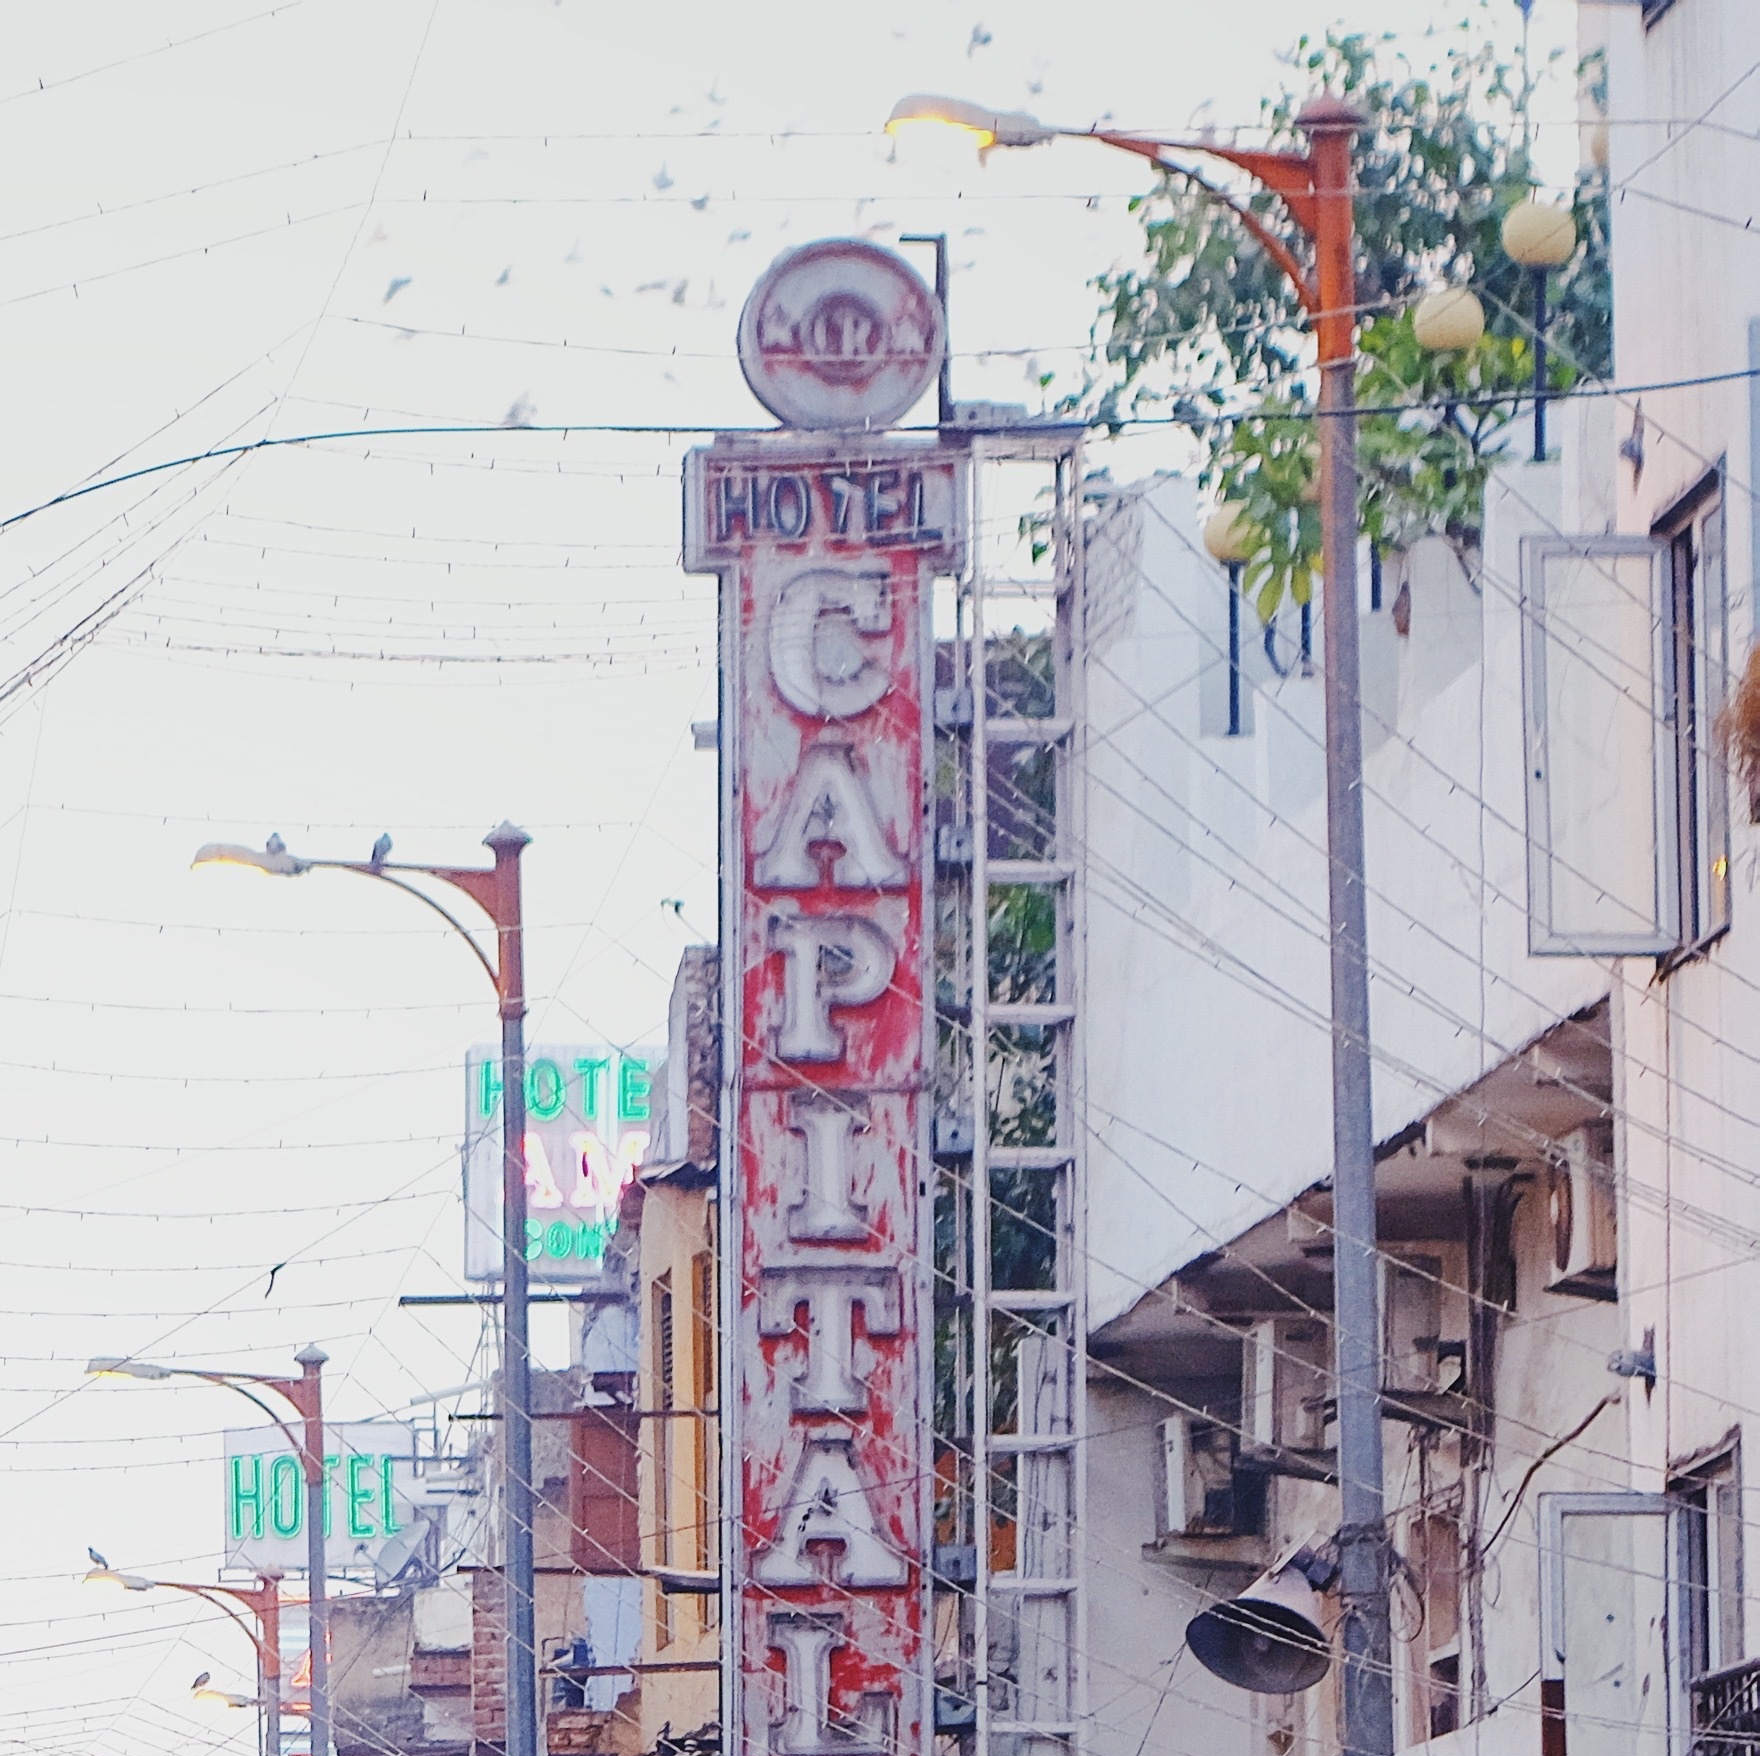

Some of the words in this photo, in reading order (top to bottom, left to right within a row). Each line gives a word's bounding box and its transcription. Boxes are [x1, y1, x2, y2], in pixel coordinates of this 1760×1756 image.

[717, 470, 944, 547] HOTEL
[478, 1058, 653, 1121] HOTE
[231, 1454, 404, 1539] HOTEL
